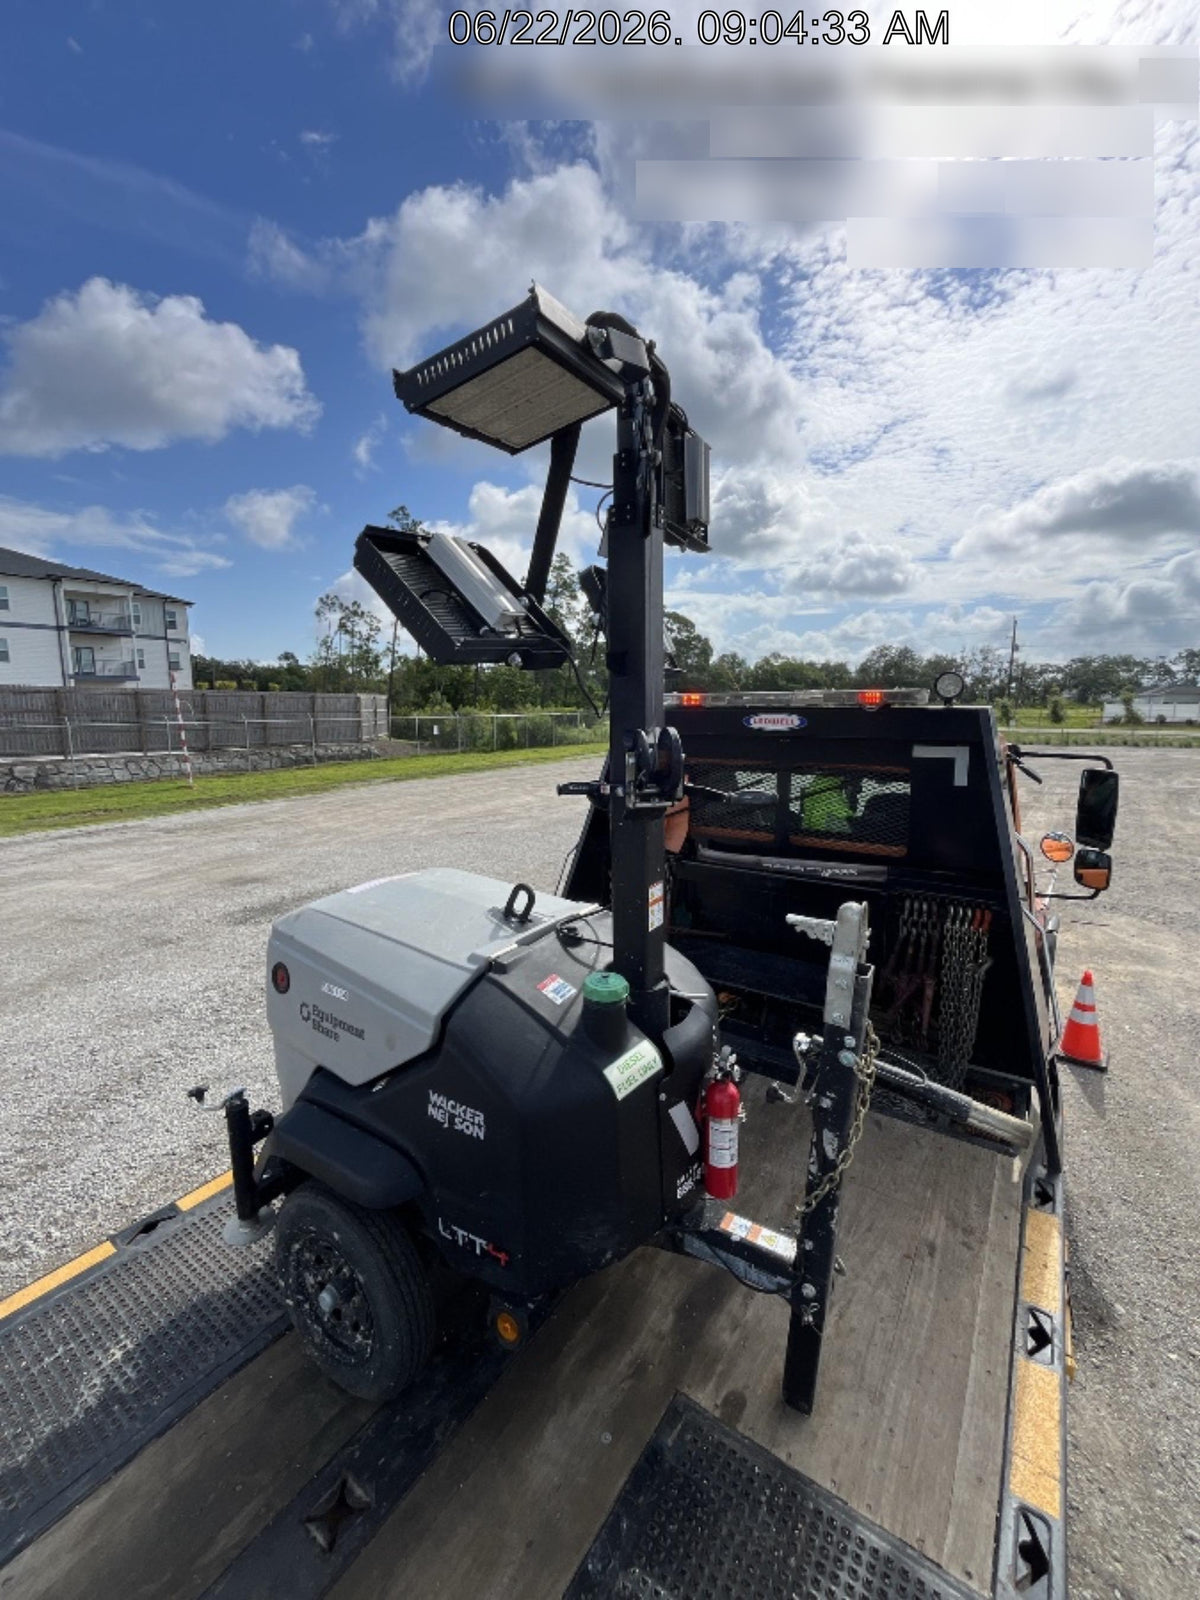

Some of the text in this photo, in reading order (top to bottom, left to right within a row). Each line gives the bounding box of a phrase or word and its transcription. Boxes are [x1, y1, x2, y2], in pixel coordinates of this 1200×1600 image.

[312, 1004, 366, 1041] Equipment
[616, 1075, 639, 1094] FUEL
[428, 1089, 485, 1126] WACKER
